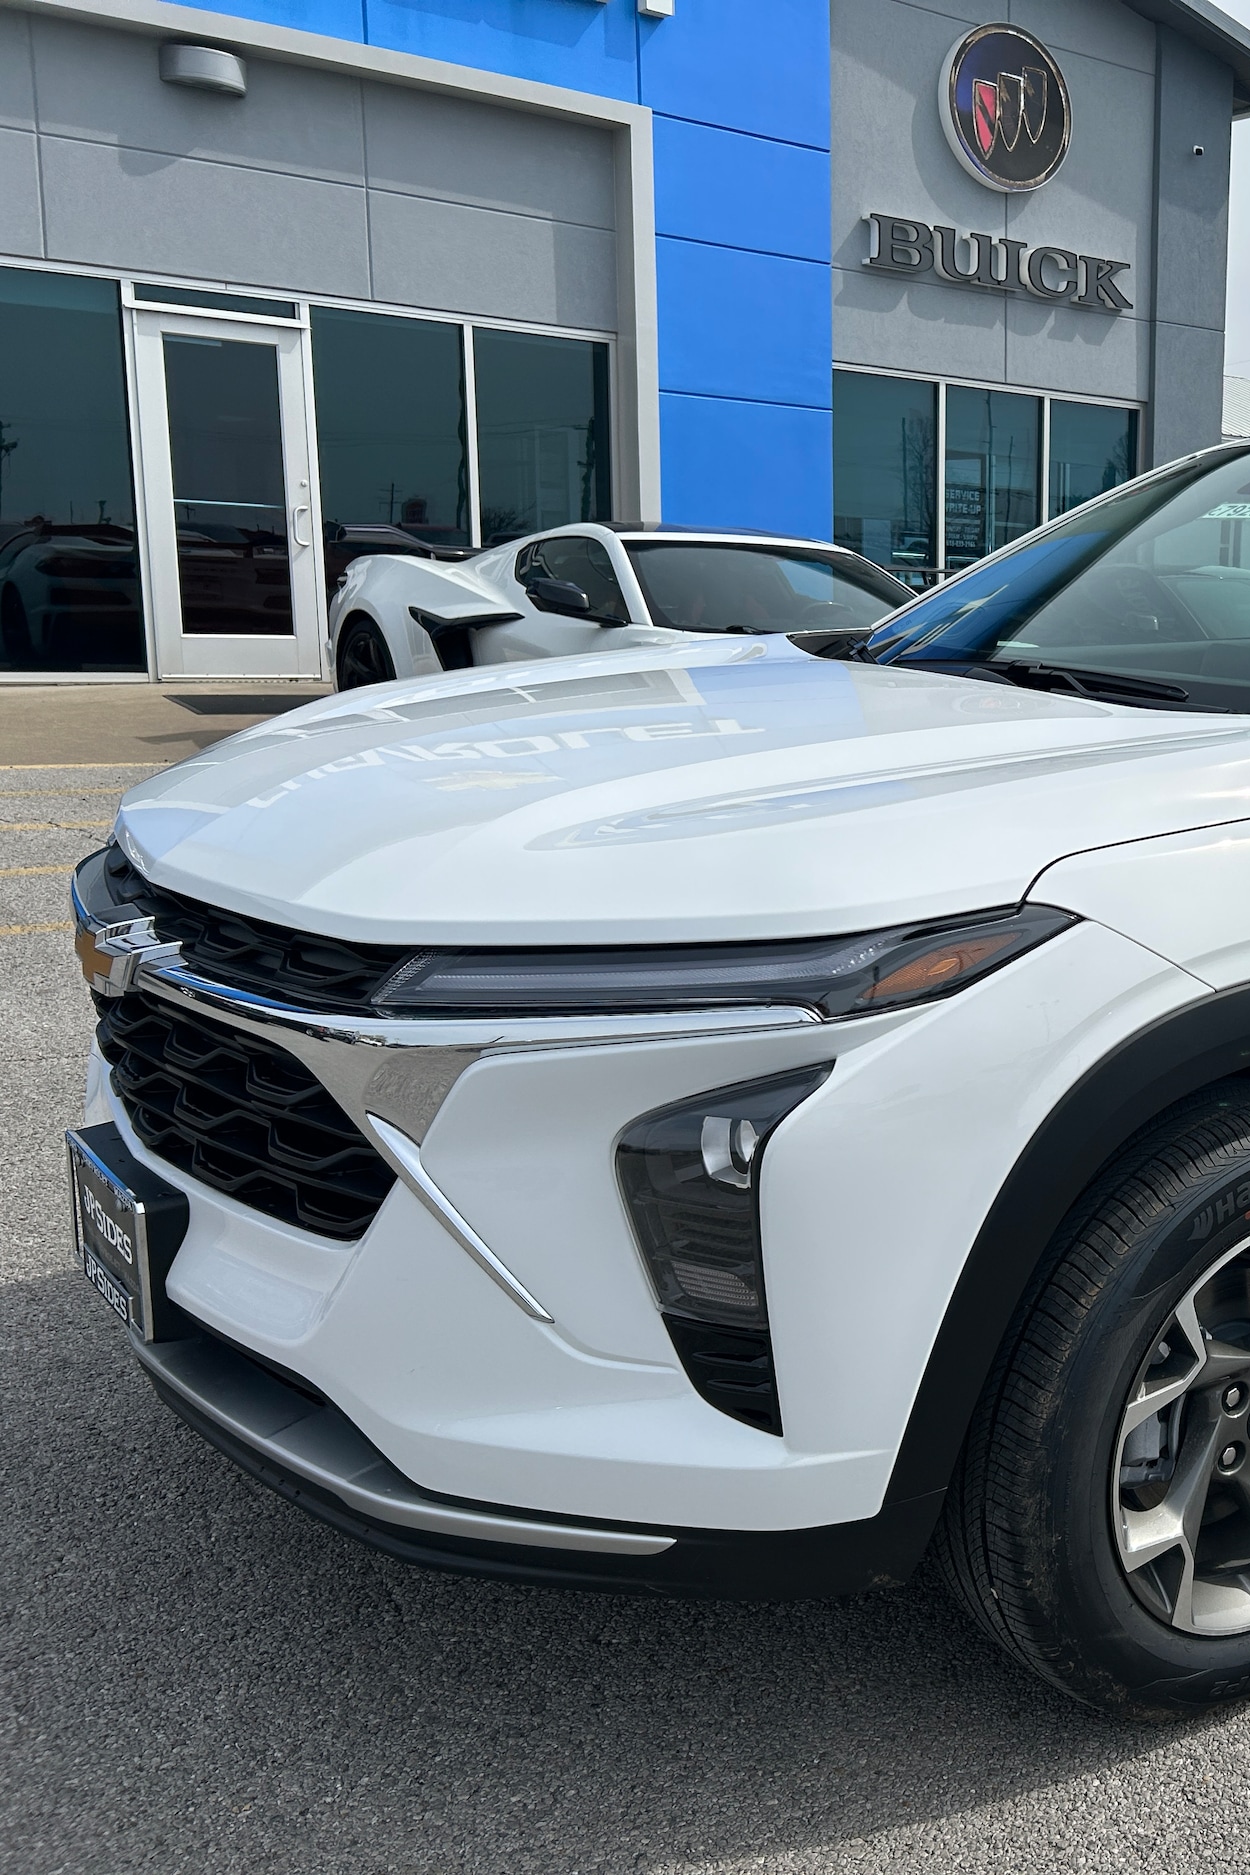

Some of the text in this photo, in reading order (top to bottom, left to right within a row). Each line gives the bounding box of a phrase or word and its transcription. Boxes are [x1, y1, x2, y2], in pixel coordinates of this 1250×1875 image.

[861, 212, 1134, 311] BUICK
[95, 1206, 133, 1266] SIDES
[96, 1264, 128, 1322] SIDES
